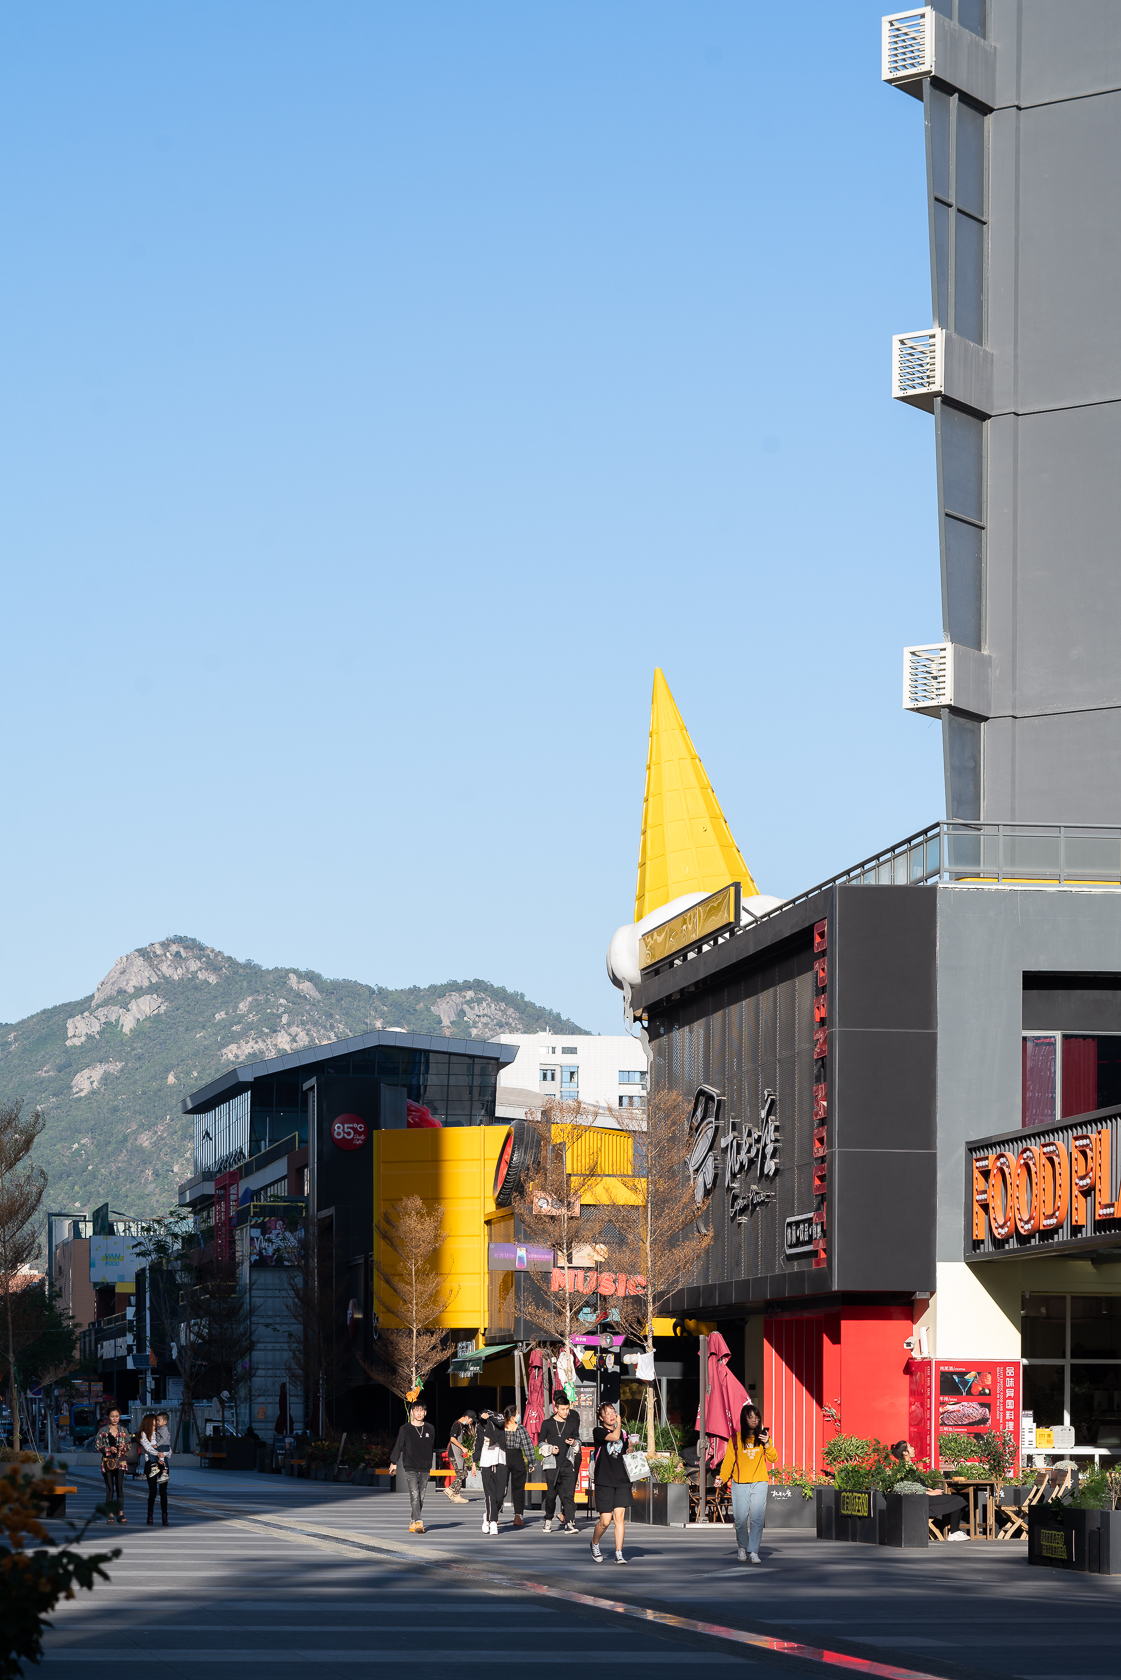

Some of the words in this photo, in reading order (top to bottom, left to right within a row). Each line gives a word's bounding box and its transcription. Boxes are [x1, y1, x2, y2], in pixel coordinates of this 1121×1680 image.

[333, 1123, 365, 1139] 85°C
[972, 1141, 1070, 1240] FOOD
[1071, 1129, 1121, 1226] PL
[550, 1268, 648, 1297] MUSIC
